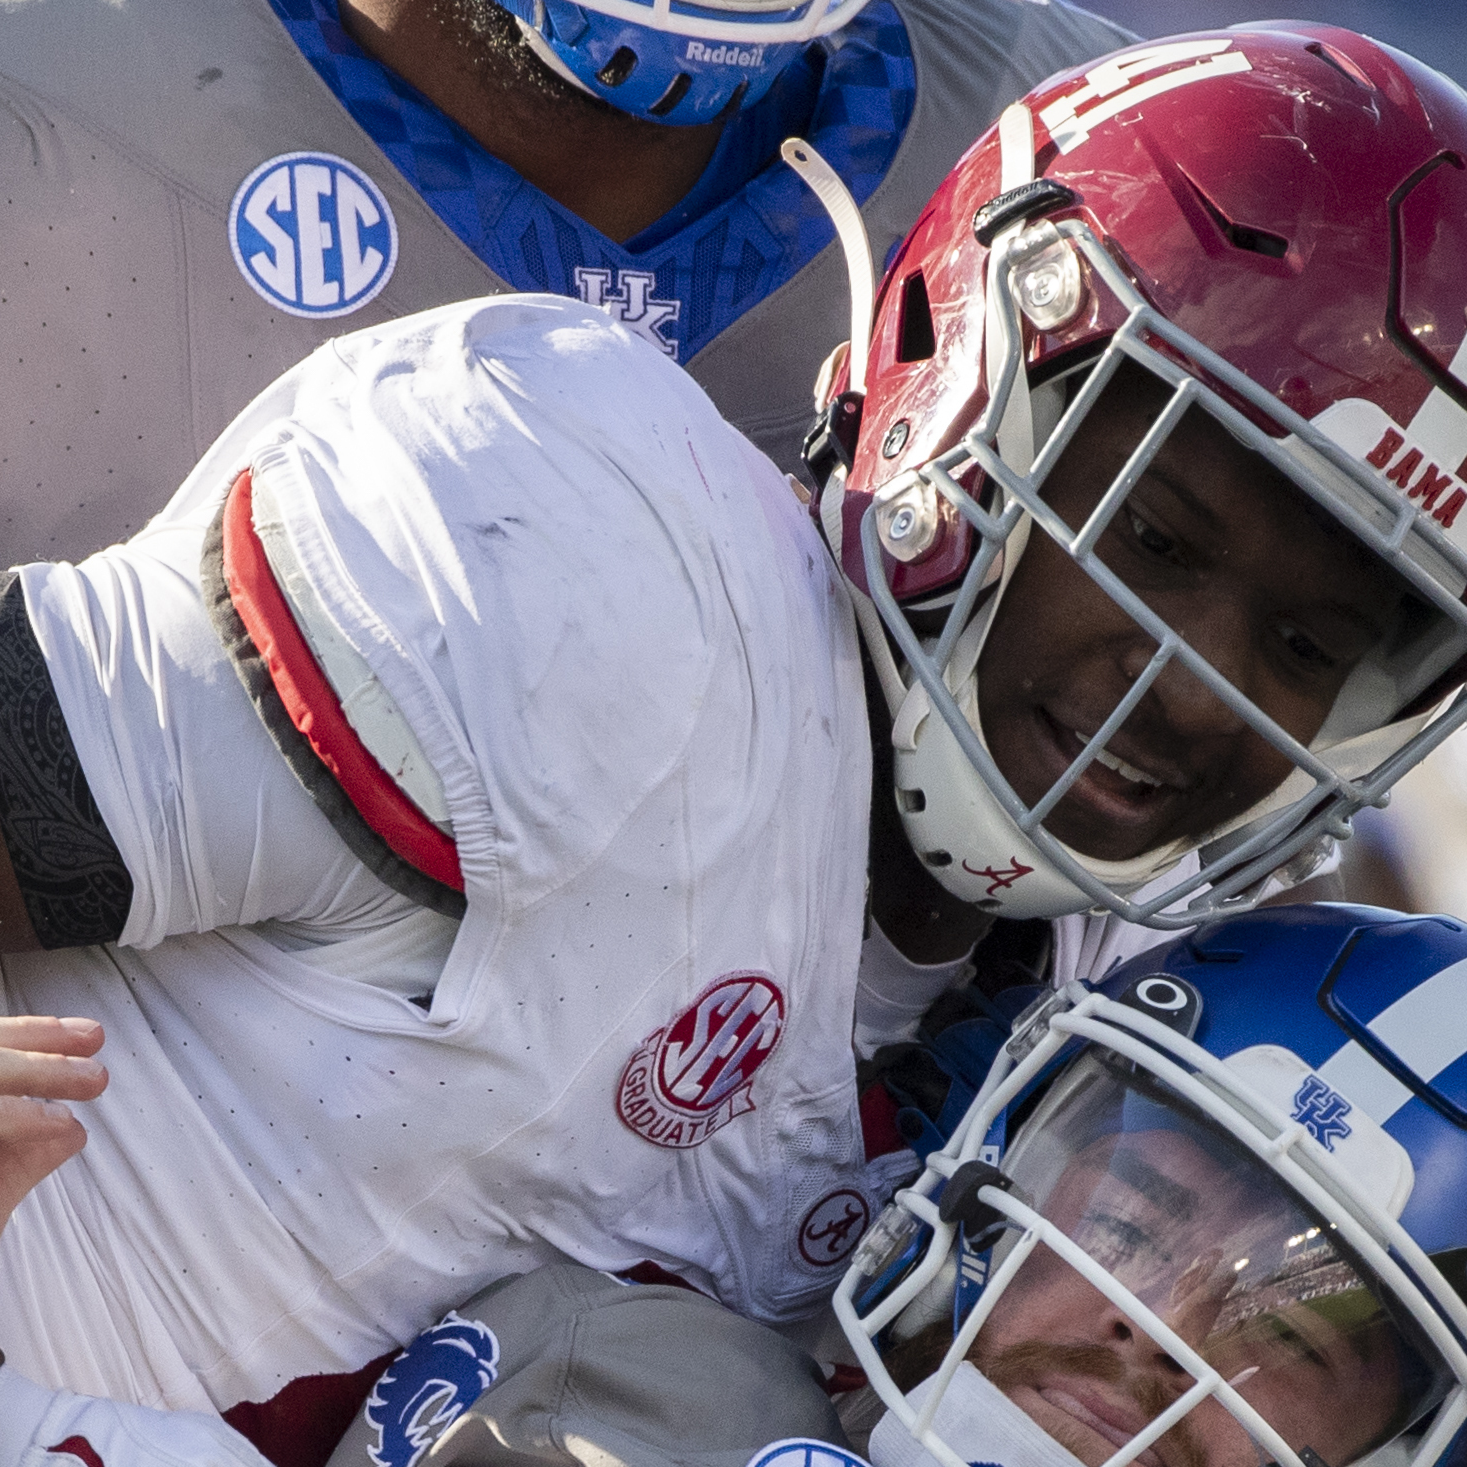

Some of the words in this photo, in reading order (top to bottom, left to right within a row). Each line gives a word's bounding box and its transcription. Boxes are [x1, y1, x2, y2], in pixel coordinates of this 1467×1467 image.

[685, 41, 765, 68] Riddell
[244, 160, 385, 304] SEC
[662, 981, 782, 1106] SEC
[624, 1066, 720, 1146] GRADUATE
[1291, 1074, 1353, 1153] UK
